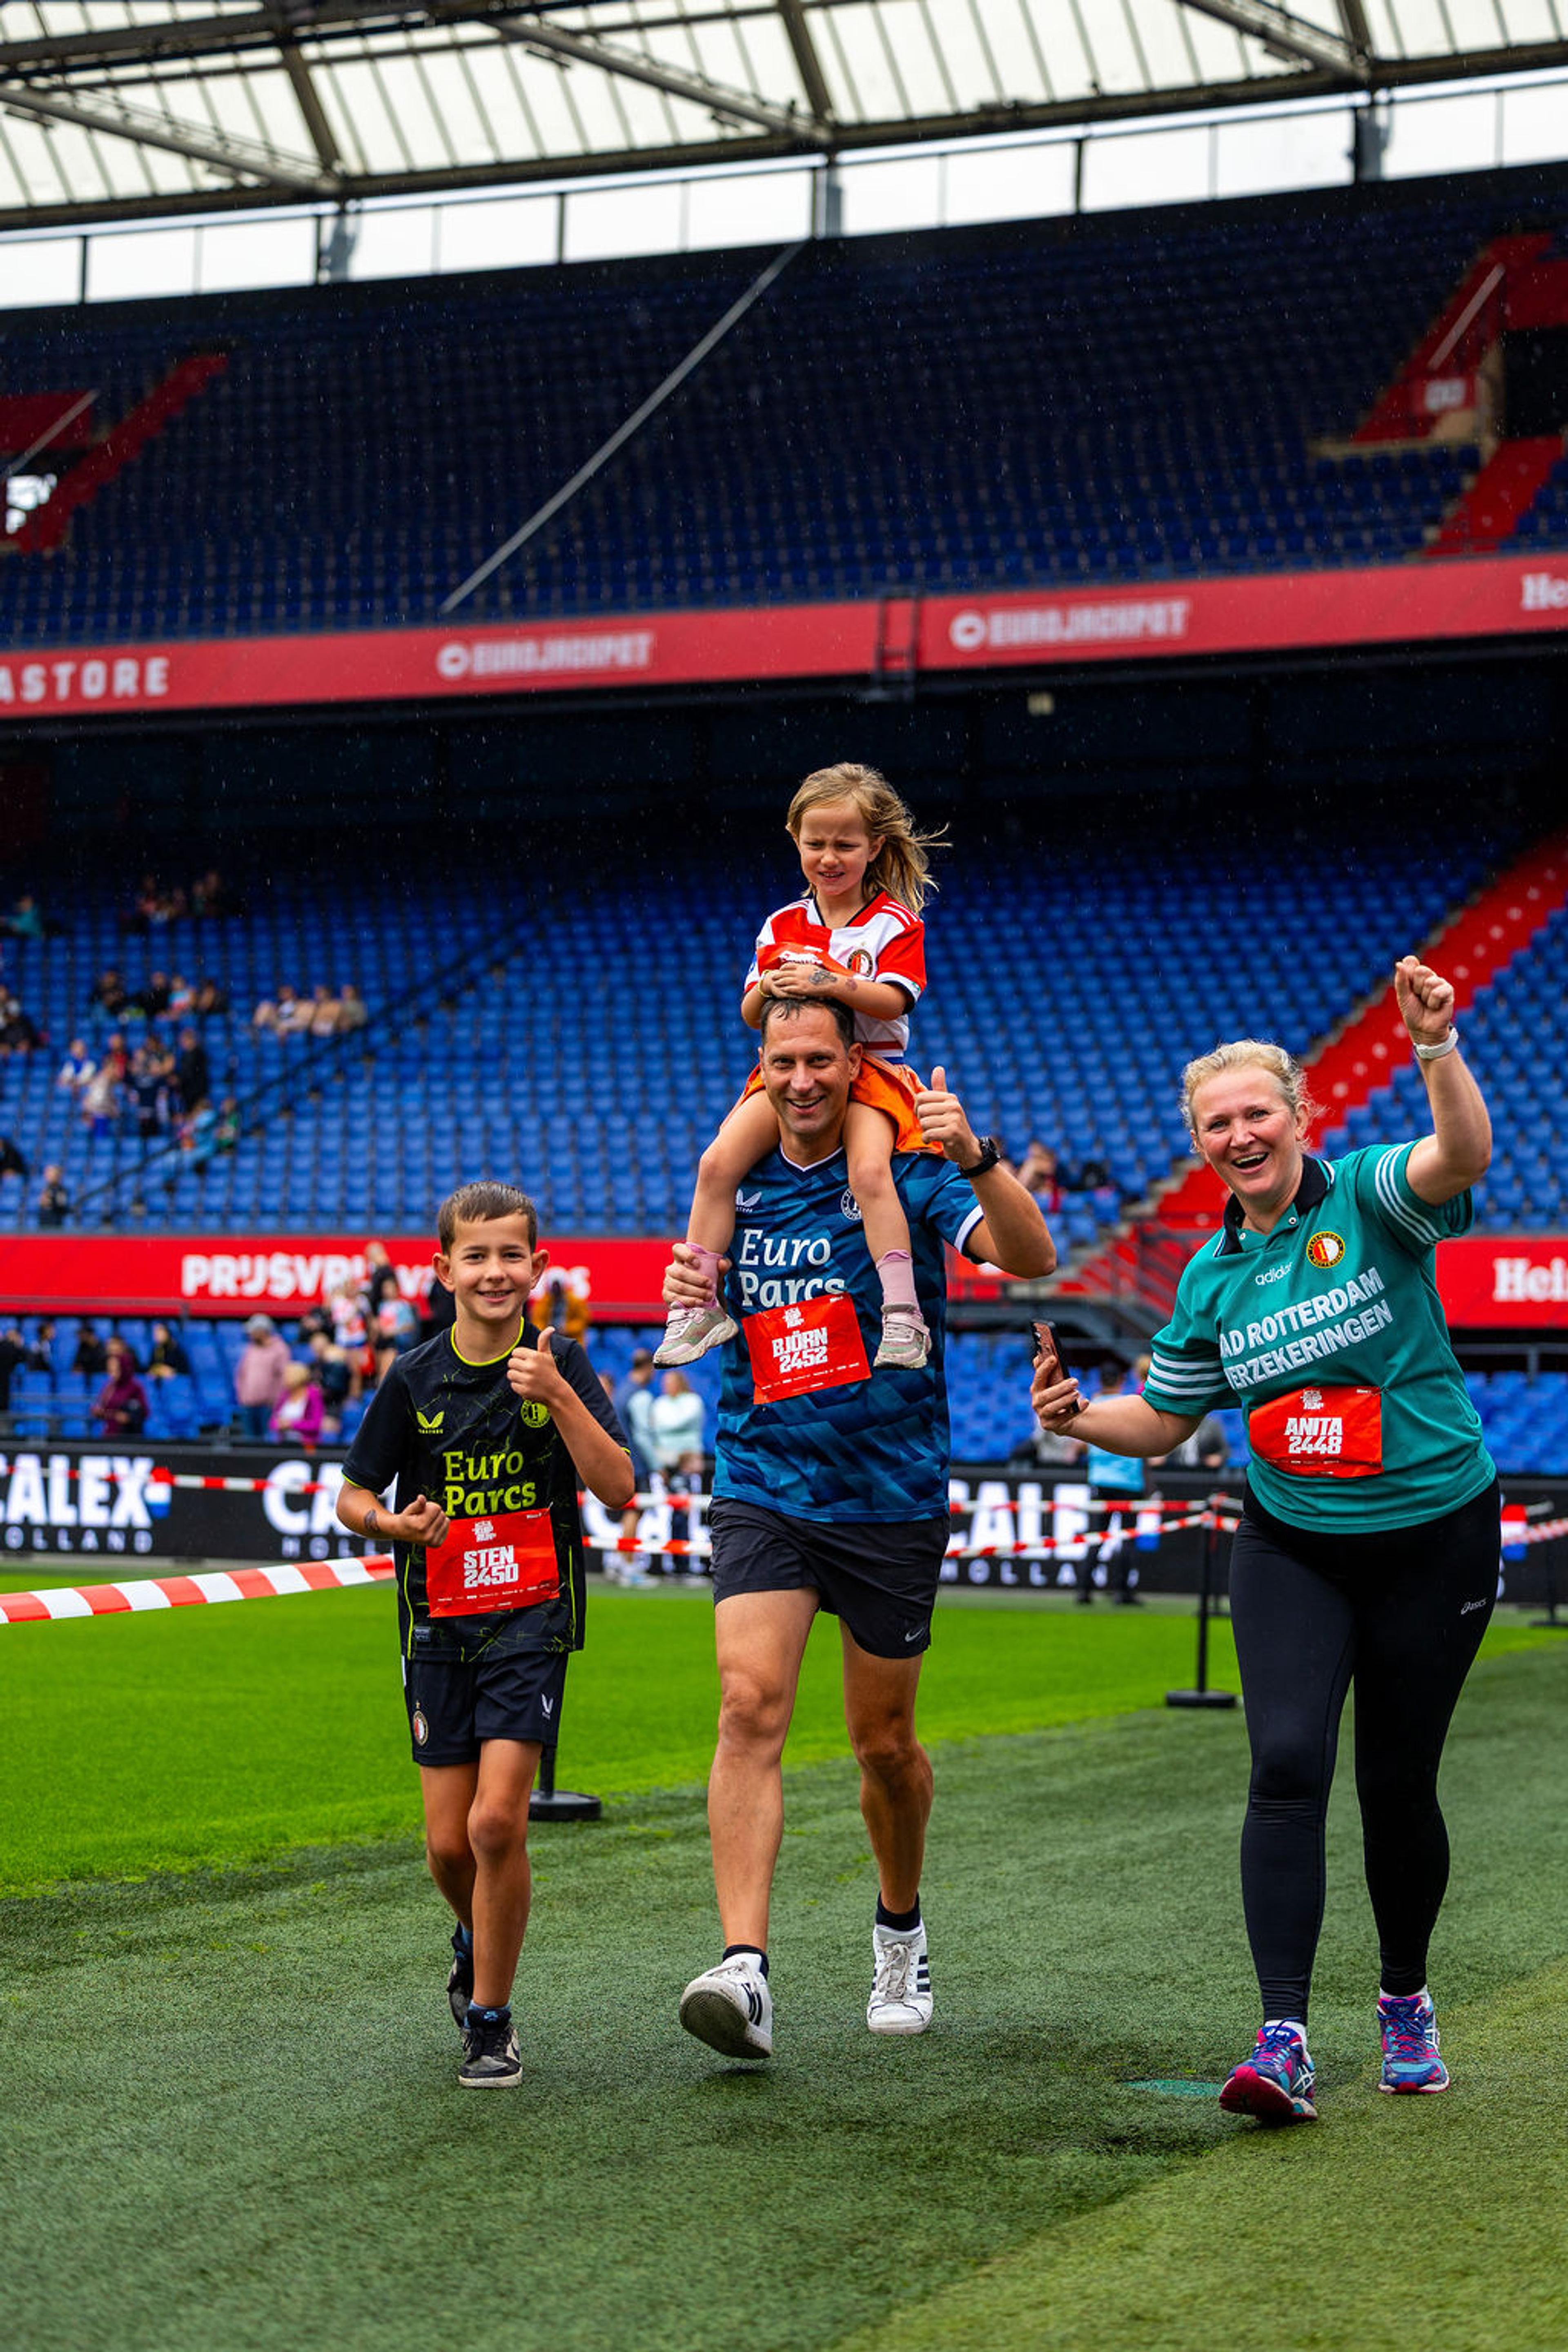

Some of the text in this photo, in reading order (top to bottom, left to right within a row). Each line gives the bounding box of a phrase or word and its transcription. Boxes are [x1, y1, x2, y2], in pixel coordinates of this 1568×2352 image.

[739, 1228, 831, 1266] Euro
[738, 1270, 845, 1308] Parcs
[1220, 1267, 1385, 1358] AD ROTTERDAM
[772, 1326, 828, 1358] BJÖRN
[1224, 1299, 1393, 1390] ERZEKERINGEN
[780, 1345, 828, 1373] 2452
[1283, 1417, 1342, 1436] ANITA
[1288, 1436, 1342, 1454] 2448
[443, 1450, 524, 1481] Euro
[0, 1453, 154, 1529] ALEX
[444, 1482, 536, 1516] Parcs
[463, 1545, 514, 1569] STEN
[463, 1563, 519, 1589] 2450
